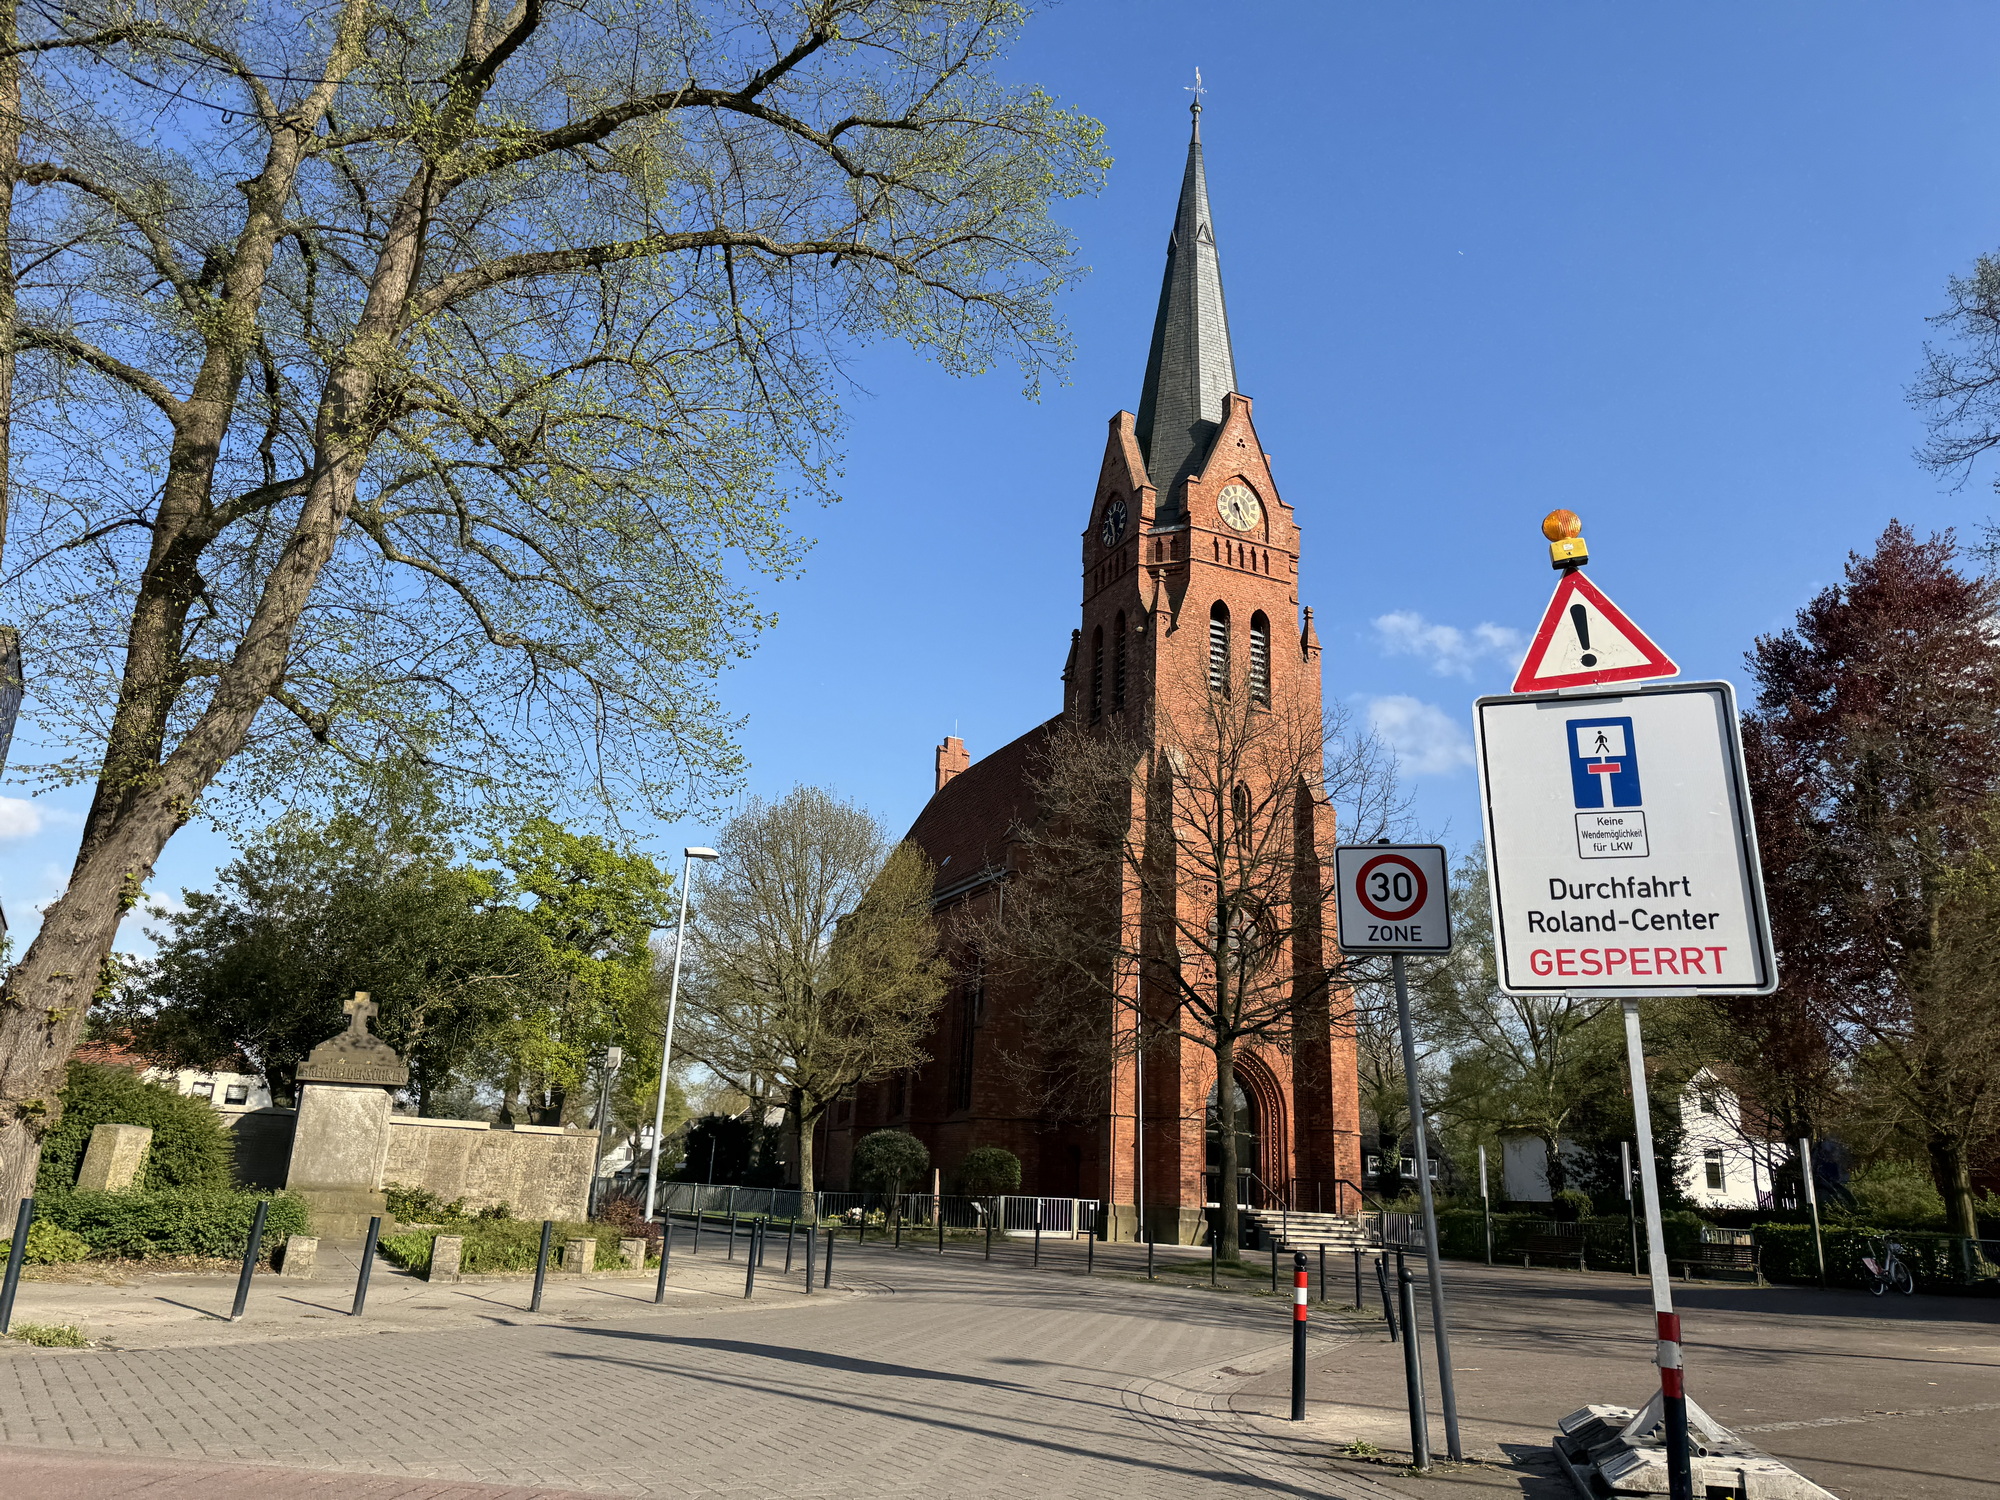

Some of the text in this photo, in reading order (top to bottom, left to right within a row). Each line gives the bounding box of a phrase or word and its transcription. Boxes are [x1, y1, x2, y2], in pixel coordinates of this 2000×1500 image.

[1596, 816, 1624, 827] Keine
[1581, 828, 1643, 842] Wendemöglichkeit
[1593, 841, 1634, 852] für LKW
[1371, 872, 1412, 902] 30
[1548, 875, 1692, 901] Durchfahrt
[1527, 909, 1721, 934] Roland-Center
[1368, 925, 1422, 942] ZONE
[1529, 946, 1728, 977] GESPERRT
